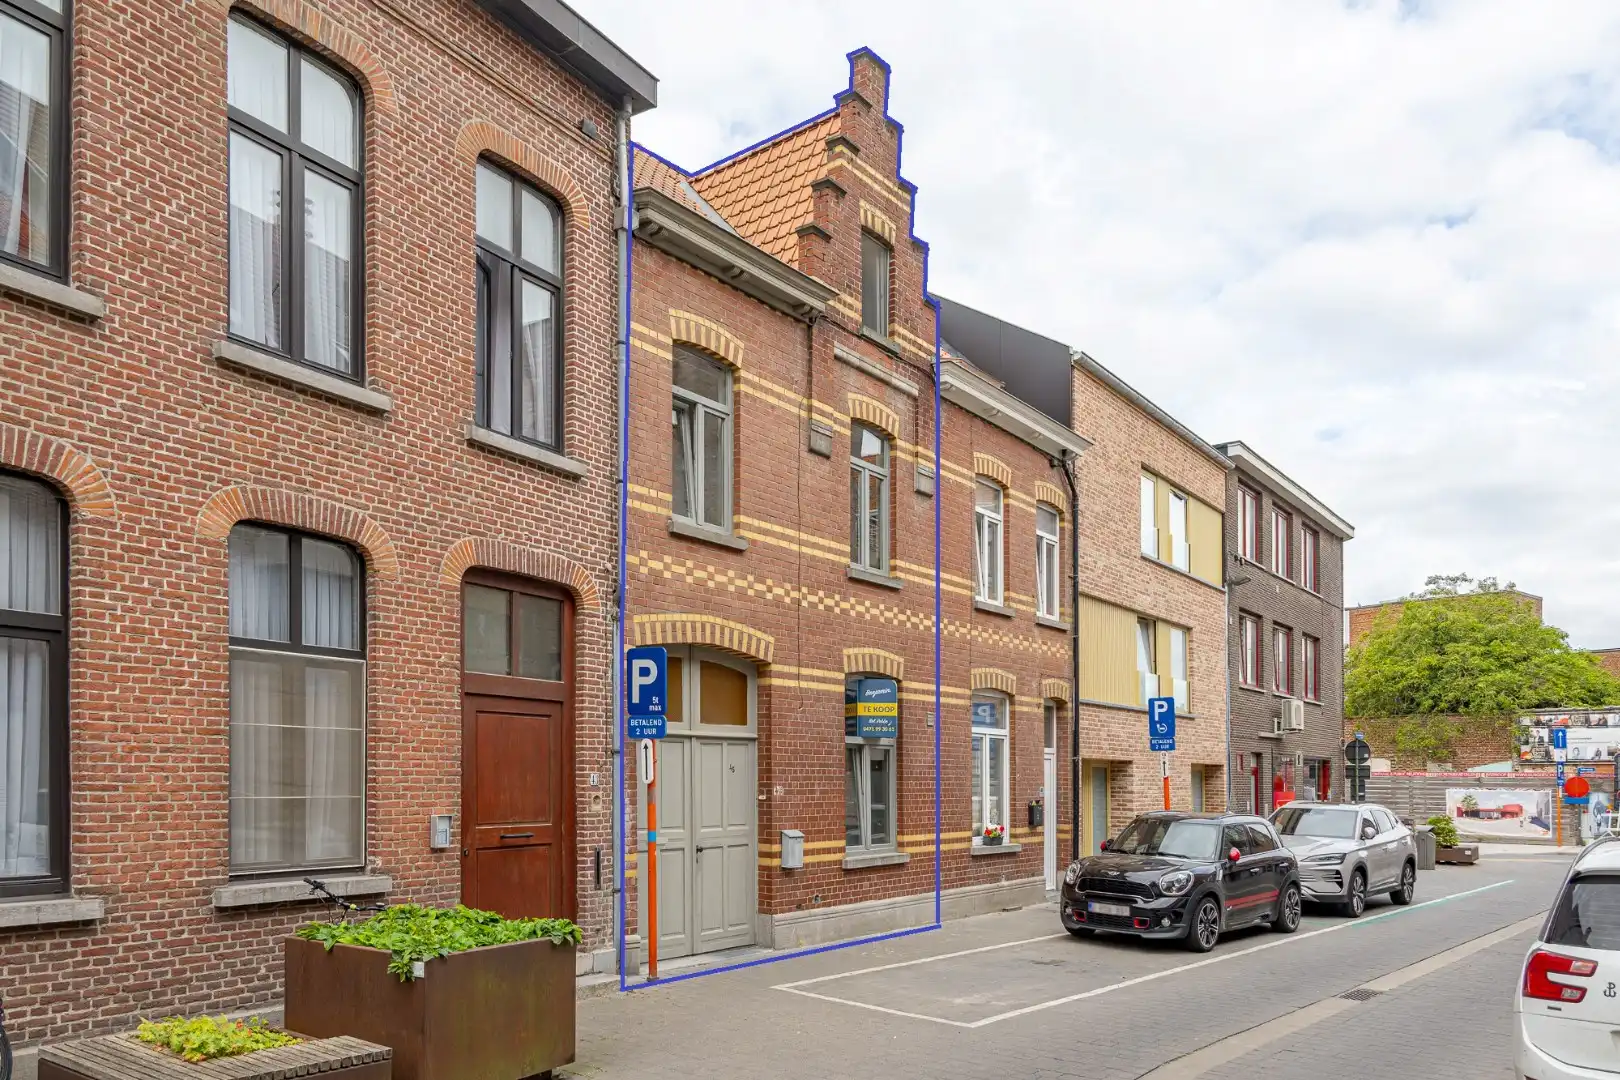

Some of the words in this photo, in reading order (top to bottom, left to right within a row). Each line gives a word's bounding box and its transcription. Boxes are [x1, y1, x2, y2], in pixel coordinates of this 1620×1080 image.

[632, 659, 658, 704] P
[1154, 700, 1168, 721] P
[1558, 765, 1563, 777] P
